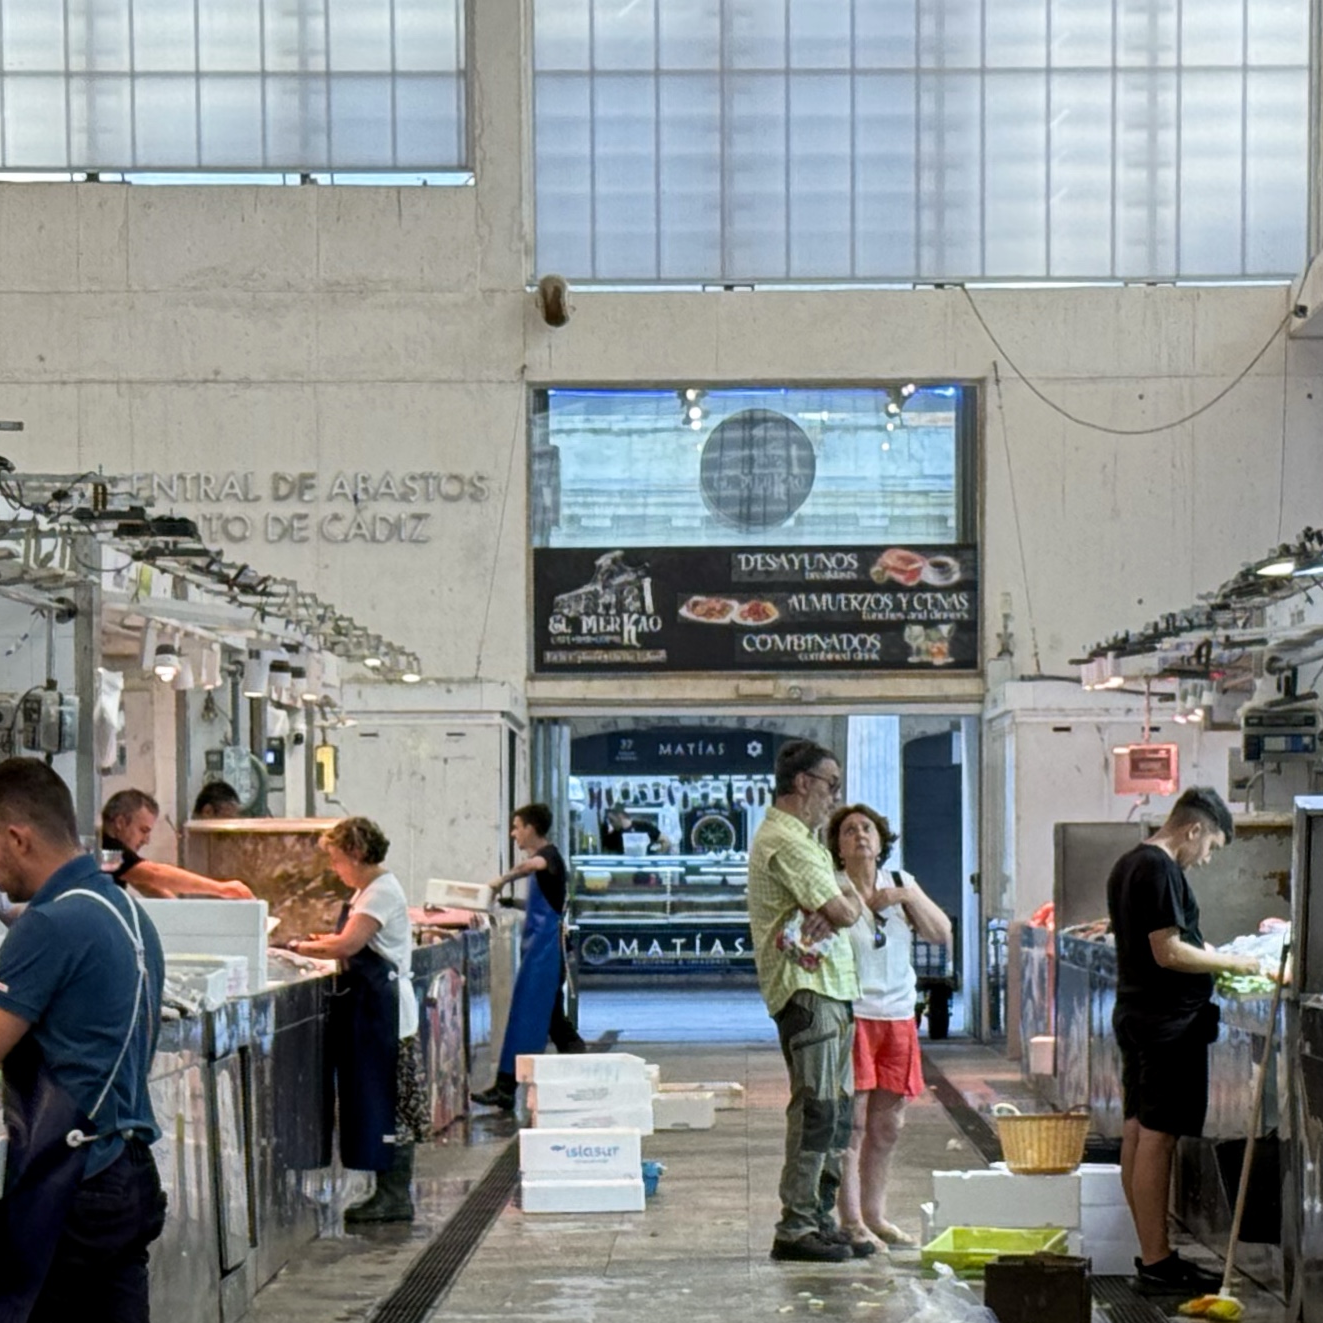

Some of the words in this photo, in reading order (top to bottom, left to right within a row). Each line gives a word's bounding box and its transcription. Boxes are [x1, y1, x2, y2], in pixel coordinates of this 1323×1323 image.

[130, 471, 262, 502] ENTRAL
[272, 471, 315, 502] DE
[327, 471, 490, 502] ABASTOS
[265, 511, 310, 543] DE
[738, 552, 858, 570] DESAYUNOS
[788, 592, 893, 612] ALMUERZOS
[897, 593, 911, 611] Y
[913, 592, 969, 611] CENAS
[742, 632, 882, 652] COMBINADOS
[658, 740, 726, 756] MATÍAS
[618, 932, 745, 957] MATÍAS
